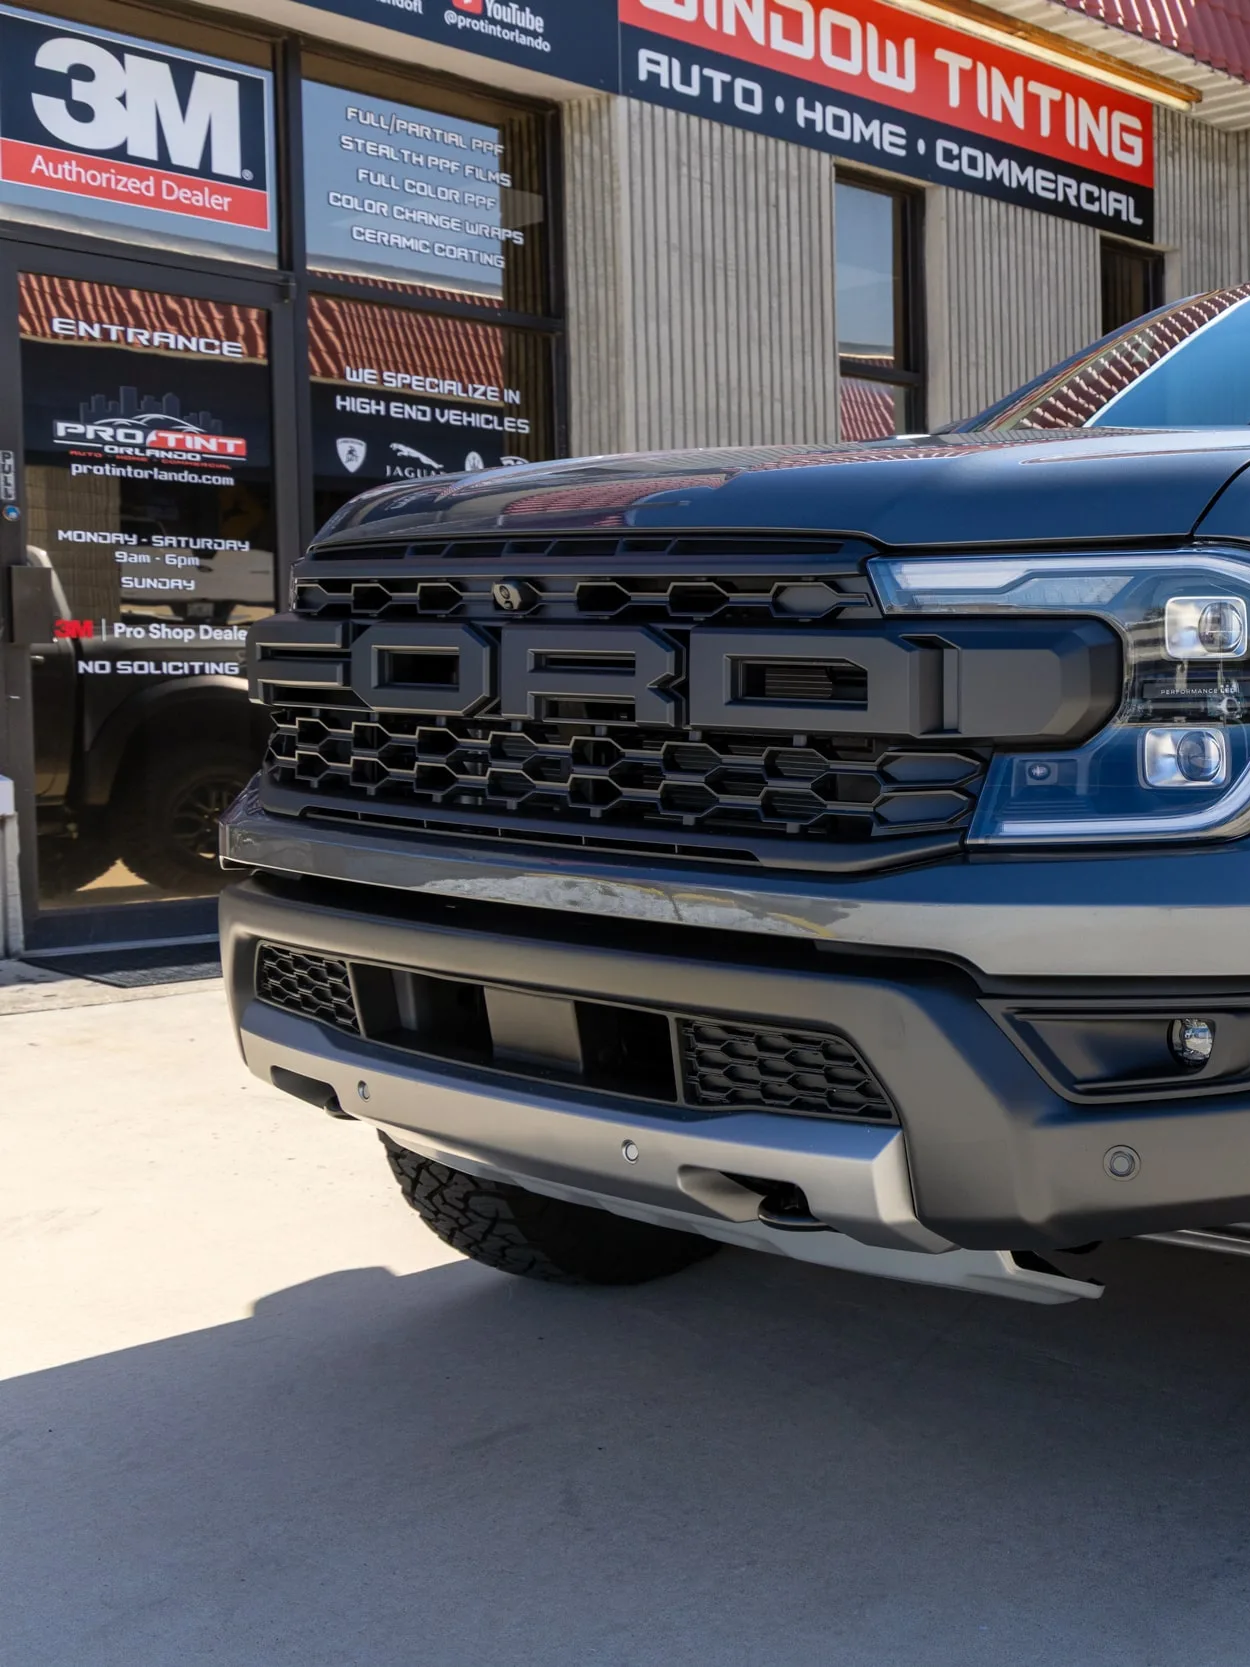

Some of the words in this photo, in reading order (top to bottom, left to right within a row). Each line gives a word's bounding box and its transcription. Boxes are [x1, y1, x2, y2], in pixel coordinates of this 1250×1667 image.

[444, 10, 551, 52] @protintorlando
[485, 0, 544, 33] YouTube
[933, 47, 1143, 167] TINTING
[346, 107, 467, 149] FULL/PARTIAL
[471, 138, 505, 157] PPF
[637, 48, 763, 115] AUTO
[796, 96, 906, 157] HOME
[936, 138, 1143, 227] COMMERCIAL
[340, 135, 425, 167] STEALTH
[427, 156, 461, 174] PPF
[464, 164, 512, 187] FILMS
[31, 154, 155, 198] Authorized
[161, 180, 232, 212] Dealer
[357, 169, 400, 190] FULL
[404, 179, 460, 203] COLOR
[464, 192, 496, 210] PPF
[328, 192, 388, 217] COLOR
[392, 206, 461, 232] CHANGE
[465, 221, 524, 245] WRAPS
[352, 226, 431, 254] CERAMIC
[433, 243, 506, 269] COATING
[52, 317, 243, 358] ENTRANCE
[345, 365, 377, 385] WE
[382, 371, 499, 401] SPECIALIZE
[504, 389, 521, 405] IN
[336, 395, 386, 415] HIGH
[390, 402, 431, 422] END
[435, 408, 530, 434] VEHICLES
[56, 421, 144, 444] PRO
[158, 432, 243, 453] TINT
[103, 444, 202, 462] ORLANDO
[1, 451, 13, 499] PULL
[70, 462, 234, 487] protintorlando.com
[385, 465, 446, 478] JAGUA
[58, 529, 137, 545] MONDAY
[152, 535, 250, 551] SATURDAY
[115, 551, 150, 563] 9am
[165, 553, 200, 568] 6pm
[121, 576, 195, 591] SUNDAY
[54, 619, 94, 639] 3M
[113, 622, 145, 640] Pro
[149, 624, 195, 642] Shop
[200, 624, 248, 641] Deale
[78, 660, 111, 674] NO
[116, 660, 240, 675] SOLICITING
[248, 614, 930, 738] FORD
[1160, 687, 1218, 695] PERFORMANCE
